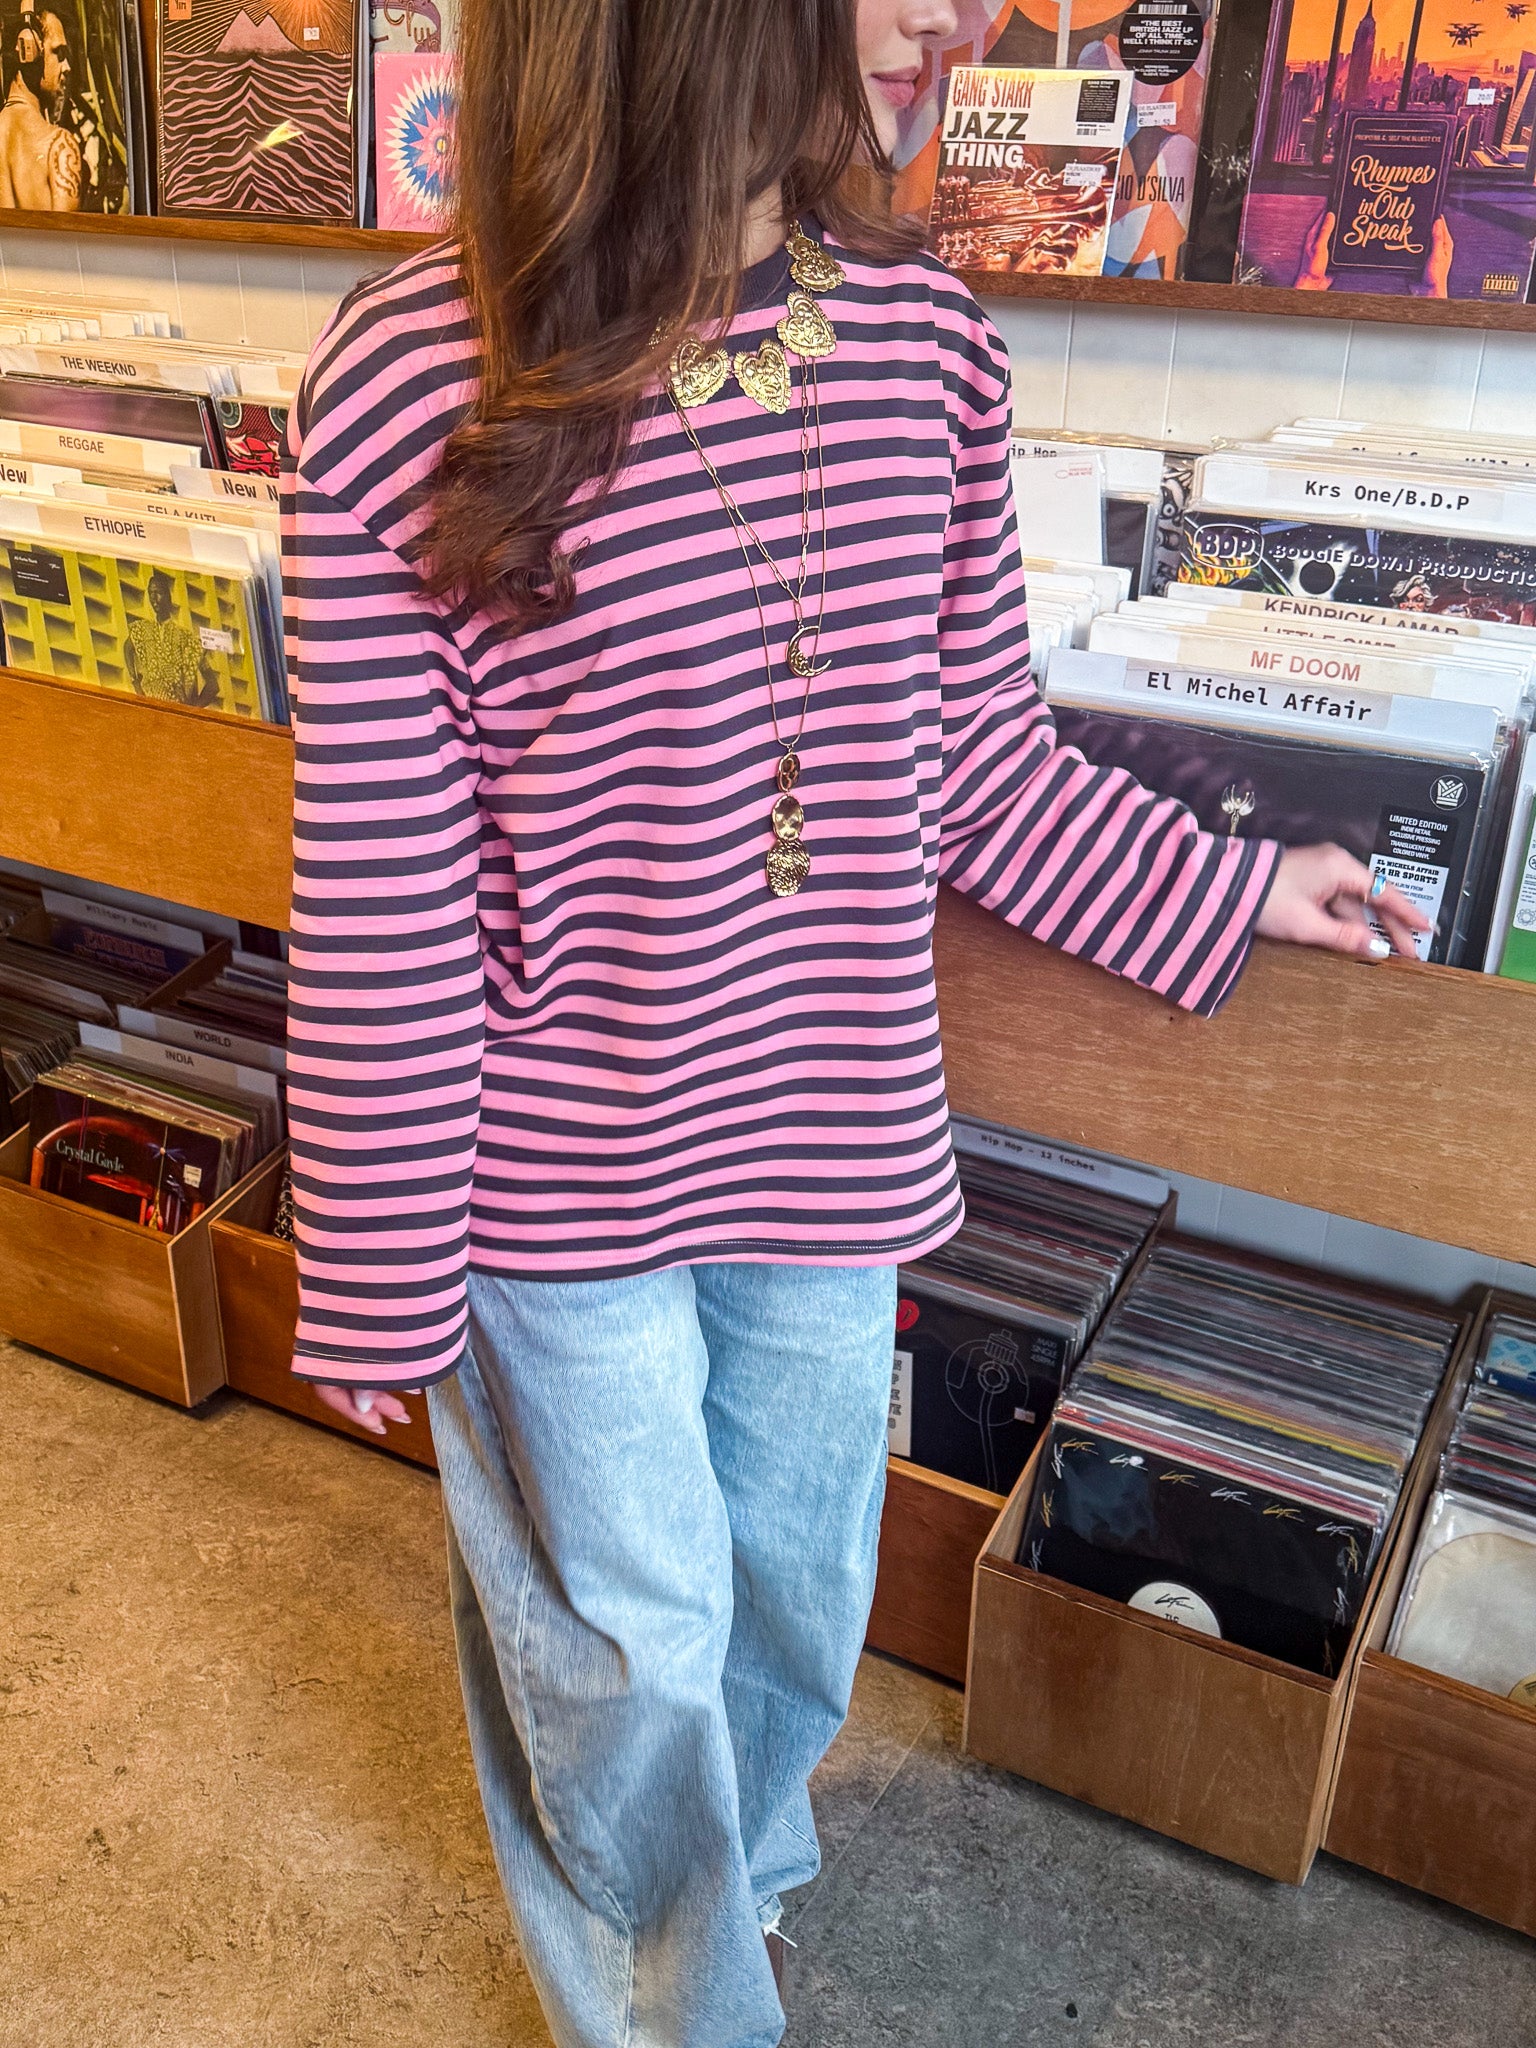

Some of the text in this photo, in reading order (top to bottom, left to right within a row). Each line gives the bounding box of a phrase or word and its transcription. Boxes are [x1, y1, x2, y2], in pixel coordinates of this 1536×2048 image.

[952, 70, 988, 108] GANG
[947, 111, 1029, 141] JAZZ
[945, 143, 1024, 169] THING
[1350, 154, 1436, 192] Rhymes
[1137, 175, 1185, 203] D'SILVA
[1358, 190, 1415, 220] in Old
[1343, 215, 1424, 254] Speak
[60, 355, 137, 377] THE WEEKND
[58, 435, 105, 453] REGGAE
[221, 477, 257, 499] New
[1305, 480, 1470, 511] Krs One/B.D.P
[84, 516, 147, 539] ETHIOPIË
[1201, 532, 1256, 560] BDP
[1272, 544, 1345, 564] BOOGIE
[1349, 552, 1413, 573] DOWN
[1264, 598, 1375, 626] KENDRICK
[1250, 650, 1361, 682] MF DOOM
[1147, 671, 1372, 721] El Michel Affair
[1389, 814, 1448, 832] LIMITED EDITION
[1389, 830, 1441, 845] EXCLUSIVE PRESSING
[1374, 866, 1386, 875] 24
[1387, 869, 1400, 878] HR
[1402, 872, 1438, 885] SPORTS
[1386, 860, 1415, 869] MICHELS
[1415, 866, 1440, 876] AFFAIR
[194, 1029, 232, 1047] WORLD
[165, 1049, 195, 1067] INDIA
[56, 1138, 125, 1174] Crystal Gayle
[981, 1134, 999, 1146] Hip
[1004, 1141, 1023, 1152] Hop
[1041, 1150, 1052, 1159] 12
[1059, 1154, 1095, 1171] inches
